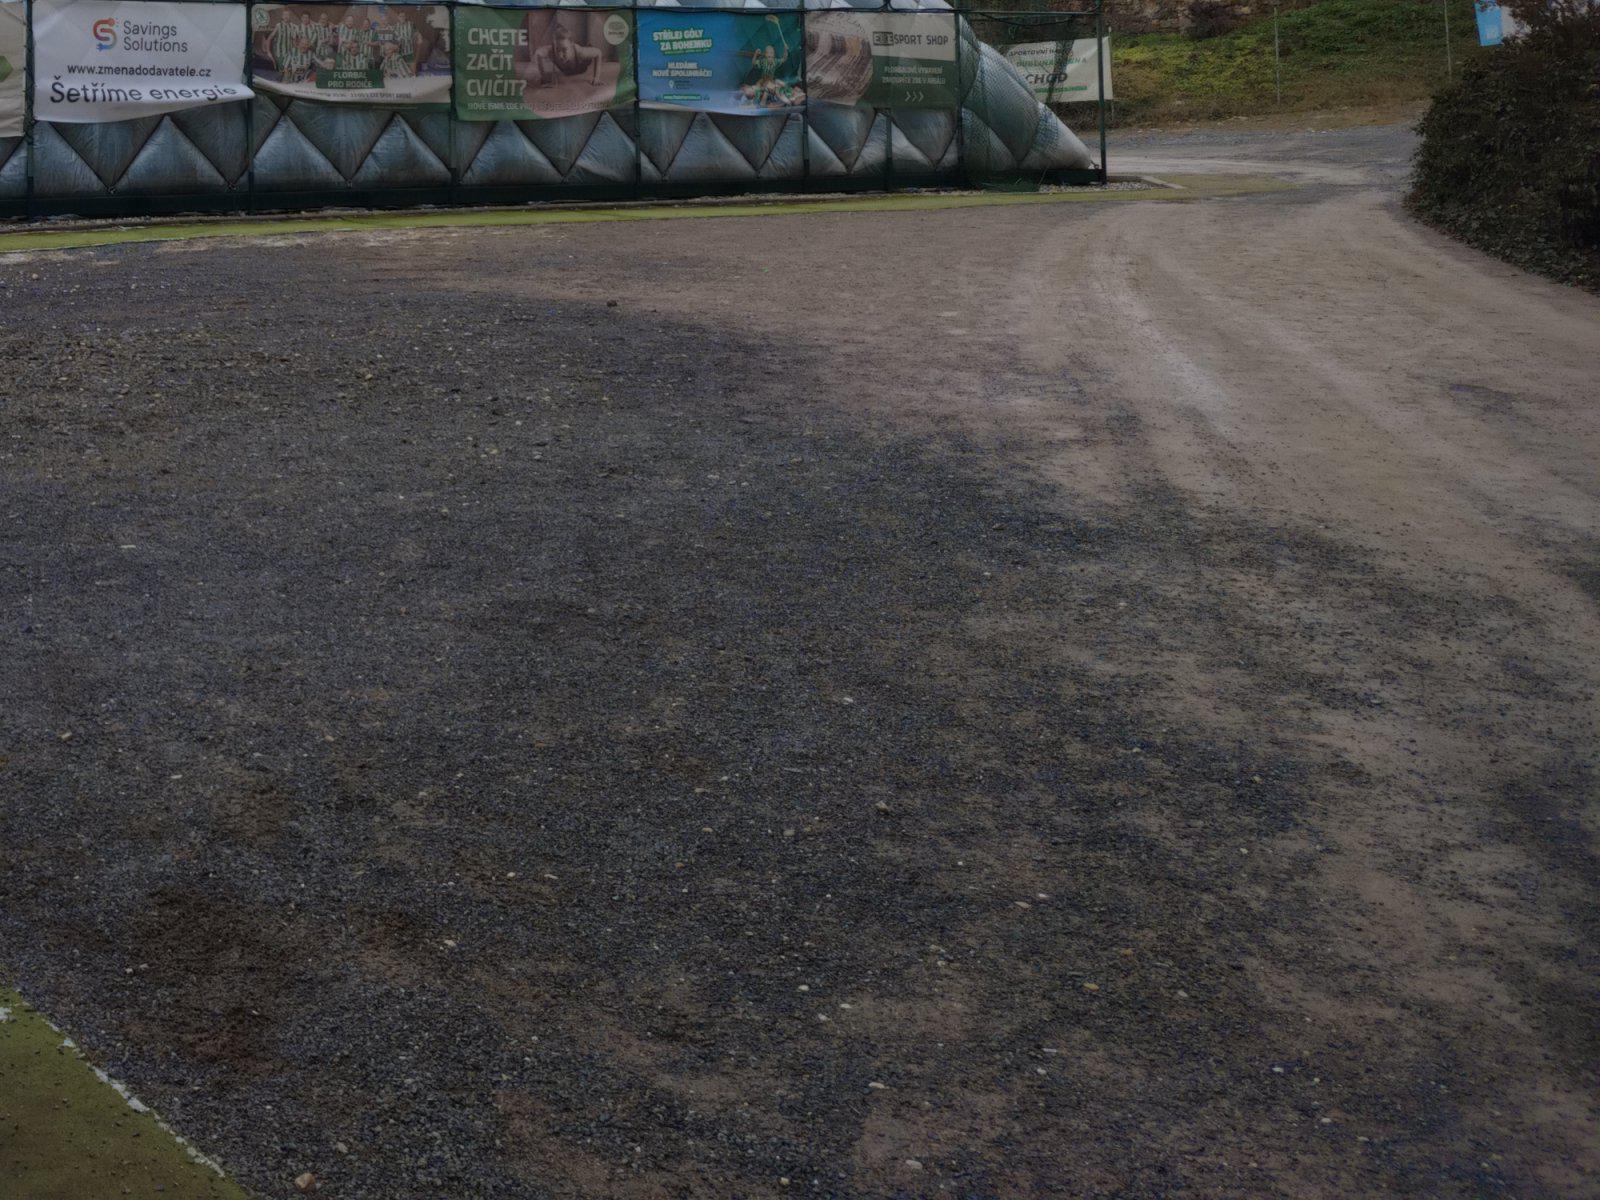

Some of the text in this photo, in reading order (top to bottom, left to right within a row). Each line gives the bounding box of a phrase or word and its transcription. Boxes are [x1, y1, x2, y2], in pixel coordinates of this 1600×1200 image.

[123, 20, 177, 40] Savings
[468, 27, 528, 46] CHCETE
[684, 27, 704, 39] GÓLY
[123, 36, 188, 53] Solutions
[660, 41, 671, 51] ZA
[894, 34, 922, 45] SPORT
[926, 35, 949, 46] SHOP
[466, 48, 513, 71] ZAČÍT
[67, 64, 212, 77] www.zmenadodavatele.cz
[51, 76, 237, 104] Šetříme energie
[466, 74, 527, 97] CVIČIT?
